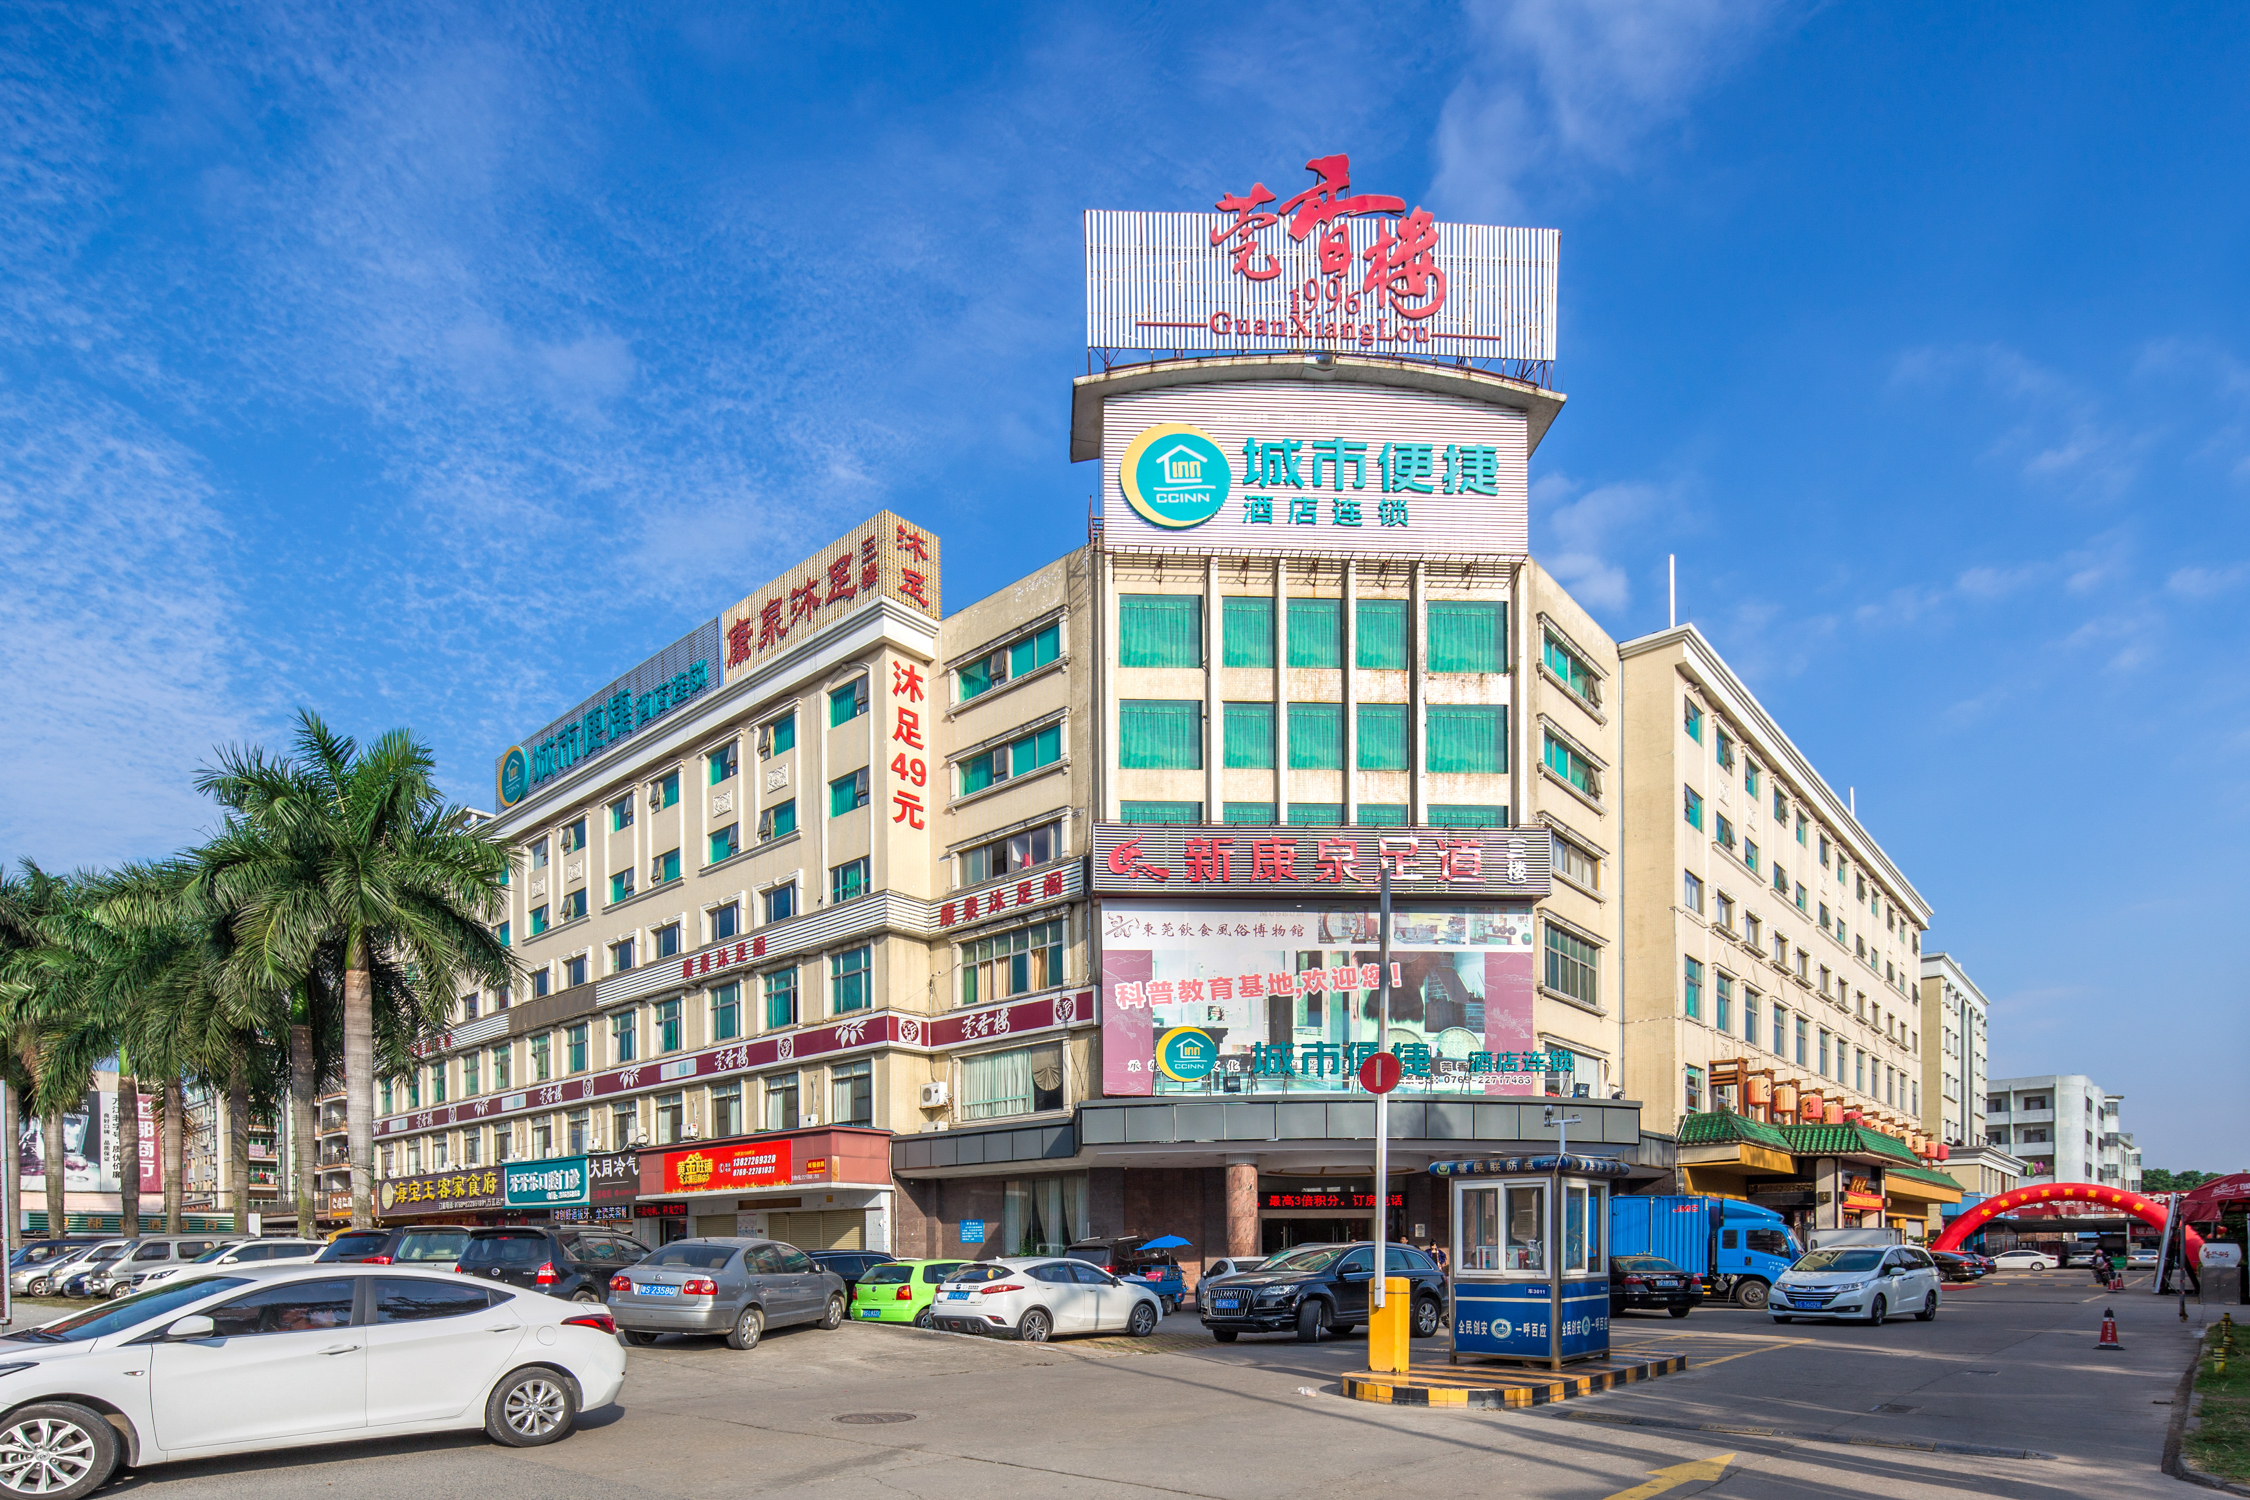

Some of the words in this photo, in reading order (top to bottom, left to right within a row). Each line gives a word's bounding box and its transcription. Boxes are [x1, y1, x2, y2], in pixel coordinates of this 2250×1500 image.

[1290, 277, 1361, 314] 1996
[1210, 311, 1430, 346] GuanXiangLou
[1242, 437, 1500, 496] 城市便捷
[1156, 493, 1210, 504] CCINN
[1242, 495, 1410, 528] 酒店连锁
[896, 524, 929, 607] 沐足
[727, 551, 858, 669] 康泉沐足
[533, 688, 633, 783] 城市便捷
[891, 660, 927, 831] 沐足49元
[1183, 836, 1487, 884] 新康泉足道
[939, 870, 1063, 927] 康泉沐足阁
[682, 935, 766, 979] 康泉沐足阁
[1469, 1050, 1574, 1073] 酒店连锁
[733, 1154, 777, 1168] 13827269328
[1457, 1160, 1536, 1174] 警民联防点
[1458, 1319, 1488, 1336] 全民创安
[1515, 1321, 1547, 1338] 一呼百应
